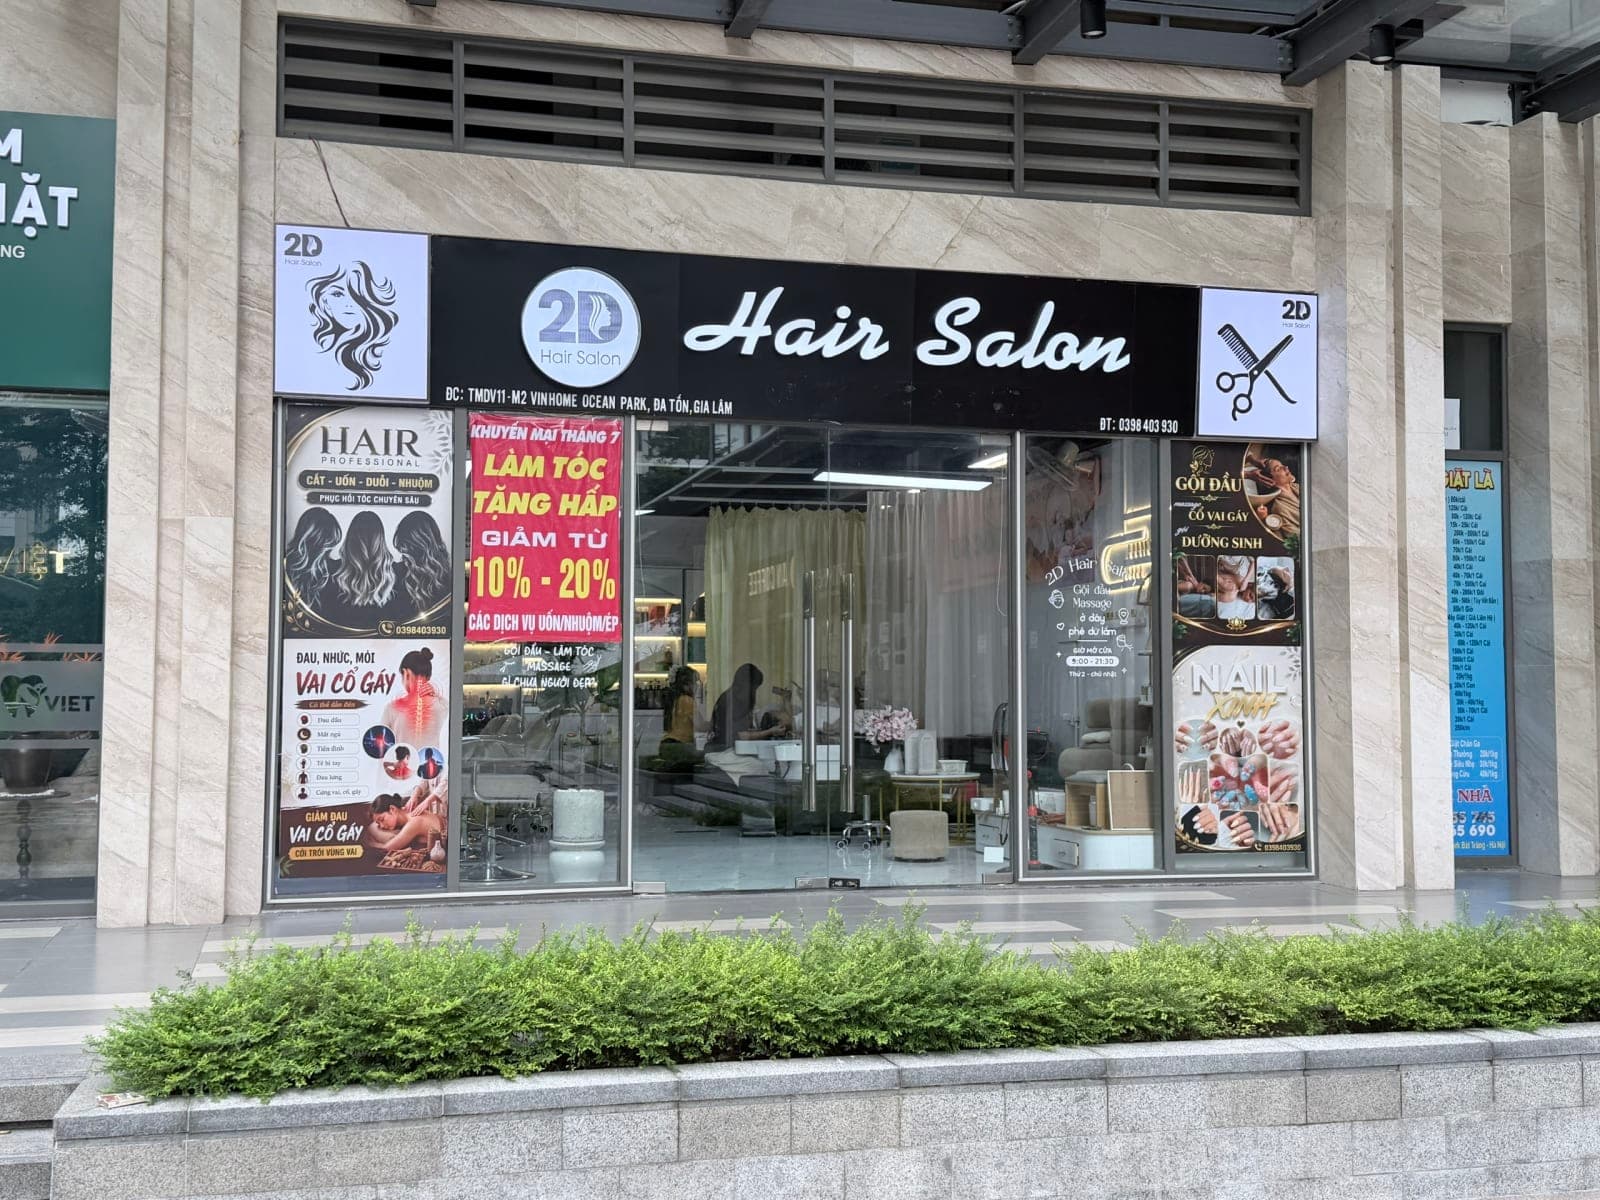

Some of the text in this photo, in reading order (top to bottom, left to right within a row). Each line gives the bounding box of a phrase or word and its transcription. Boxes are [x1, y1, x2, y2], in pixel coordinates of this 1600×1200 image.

[0, 172, 78, 238] ẶT
[284, 232, 323, 257] 2D
[538, 288, 623, 344] 2D
[1282, 299, 1312, 321] 2D
[683, 286, 1131, 373] Hair Salon
[541, 349, 621, 367] Hair Salon
[445, 386, 464, 401] ĐC:
[530, 391, 578, 408] VINHOME
[582, 393, 616, 409] OCEAN
[620, 396, 651, 413] PARK,
[653, 397, 667, 413] ĐA
[712, 398, 733, 415] LÂM
[470, 421, 621, 445] KHUYẾN MẠI THÁNG 7
[1118, 418, 1142, 432] 0398
[1143, 419, 1160, 433] 403
[1161, 419, 1179, 434] 930
[320, 425, 423, 457] HAIR
[321, 456, 421, 468] PROFESSIONAL
[483, 448, 608, 480] LÀM TÓC
[1175, 472, 1242, 494] GỘI ĐẦU
[474, 484, 617, 521] TẶNG HẤP
[1207, 511, 1225, 521] VAI
[1227, 509, 1249, 522] GÁY
[481, 526, 608, 549] GIẢM TỪ
[1182, 533, 1263, 549] DƯỠNG SINH
[473, 556, 531, 598] 10%
[559, 557, 616, 600] 20%
[1045, 565, 1064, 586] 2D
[1068, 558, 1098, 573] Hair
[1073, 597, 1112, 611] Massage
[469, 610, 491, 631] CÁC
[493, 613, 519, 634] DỊCH
[522, 614, 535, 634] VỤ
[296, 652, 320, 665] ĐAU,
[526, 661, 572, 672] MASSAGE
[296, 666, 396, 696] VAI CỔ GÁY
[1192, 664, 1288, 696] NAIL
[305, 810, 328, 822] GIẢM
[289, 821, 364, 844] VAI CỔ GÁY
[1469, 824, 1496, 837] 690
